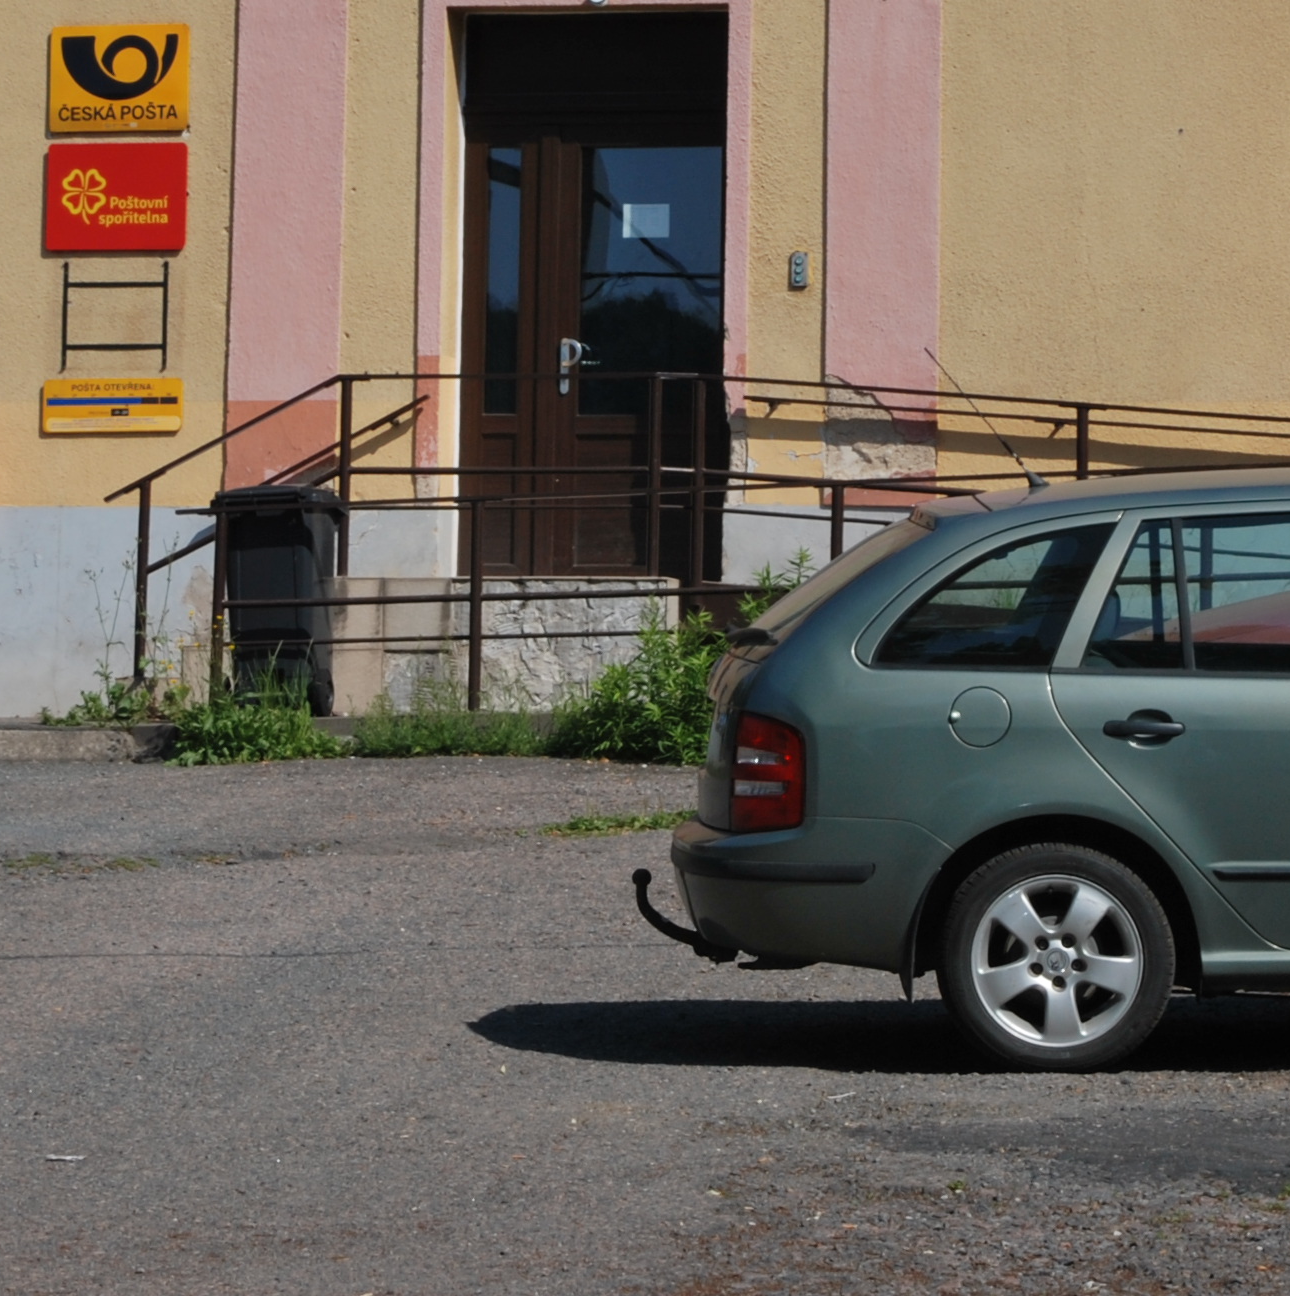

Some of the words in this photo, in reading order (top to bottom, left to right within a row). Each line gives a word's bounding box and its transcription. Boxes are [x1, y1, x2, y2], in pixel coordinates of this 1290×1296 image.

[58, 104, 117, 122] ČESKÁ
[120, 102, 178, 120] POŠTA
[110, 195, 168, 209] Poštovní
[98, 210, 168, 228] spořitelna
[71, 383, 101, 392] POŠTA
